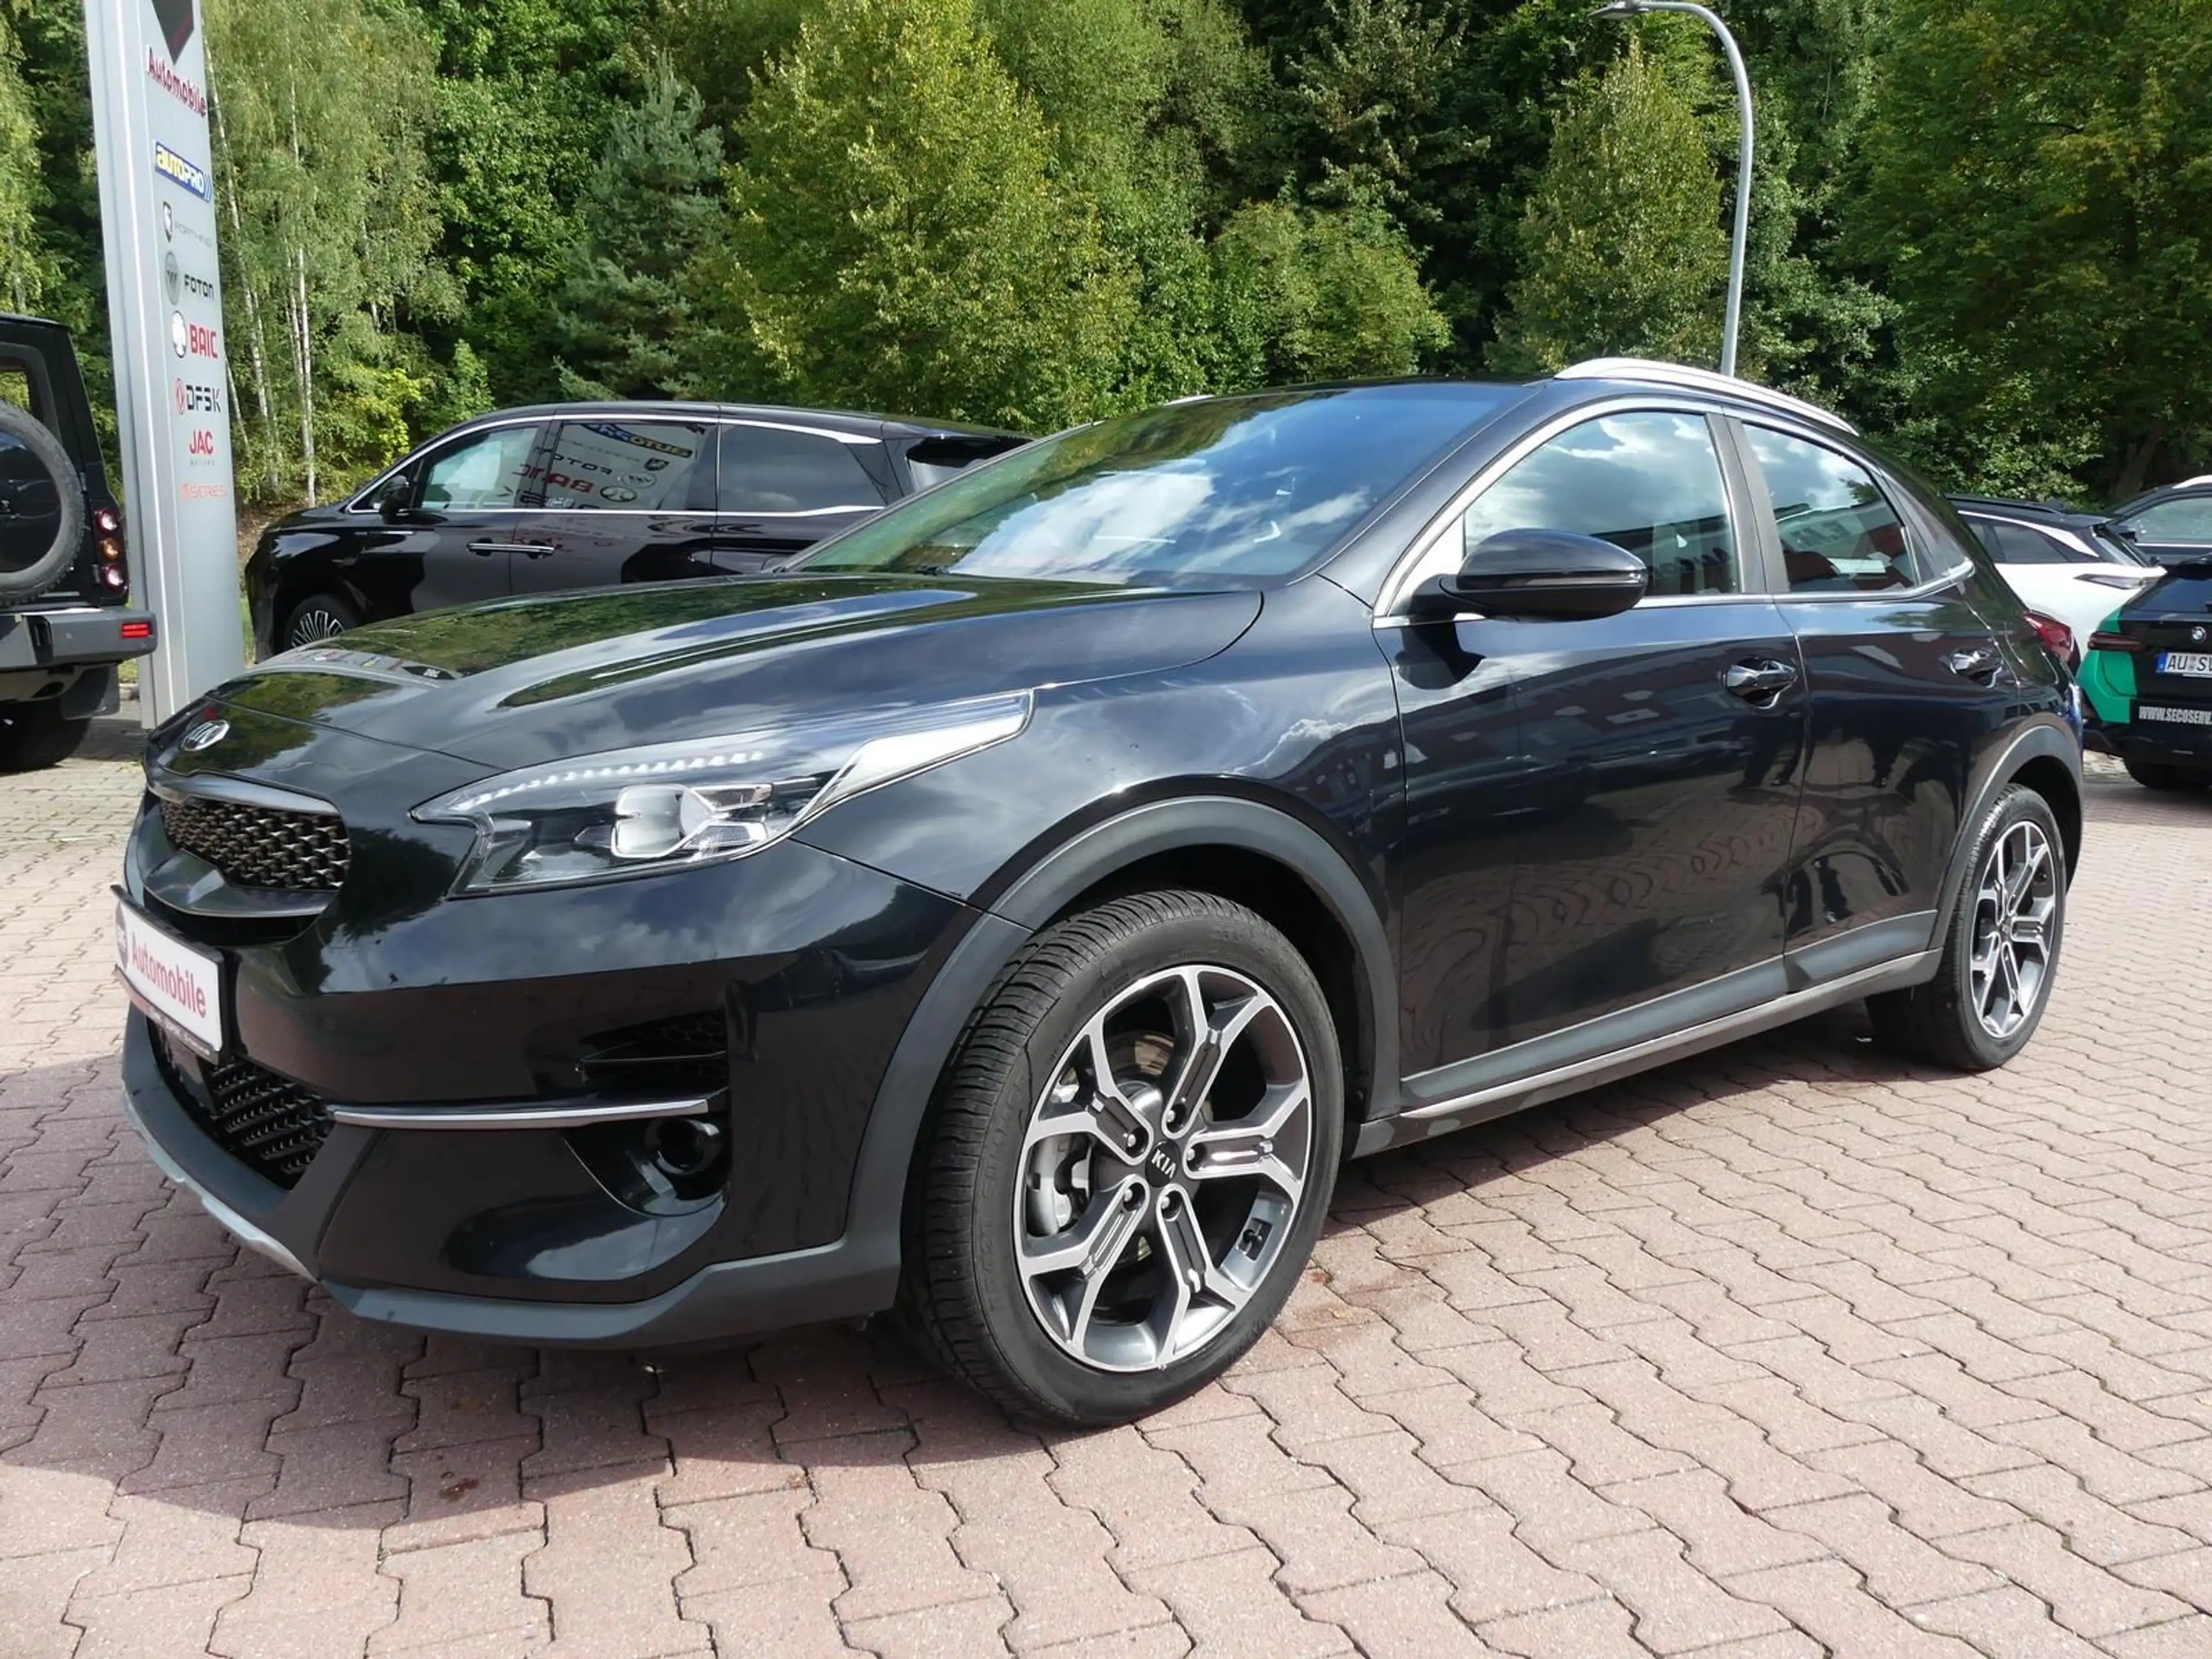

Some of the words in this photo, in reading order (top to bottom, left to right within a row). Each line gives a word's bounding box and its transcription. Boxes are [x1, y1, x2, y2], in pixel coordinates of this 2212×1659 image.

[147, 45, 206, 118] Automobile
[184, 273, 215, 300] FOTON
[189, 323, 218, 359] BAIC
[185, 384, 221, 413] DFSK
[189, 429, 214, 454] JAC
[2168, 654, 2188, 671] AU
[132, 931, 207, 1019] Automobile
[1152, 1149, 1176, 1179] KIA
